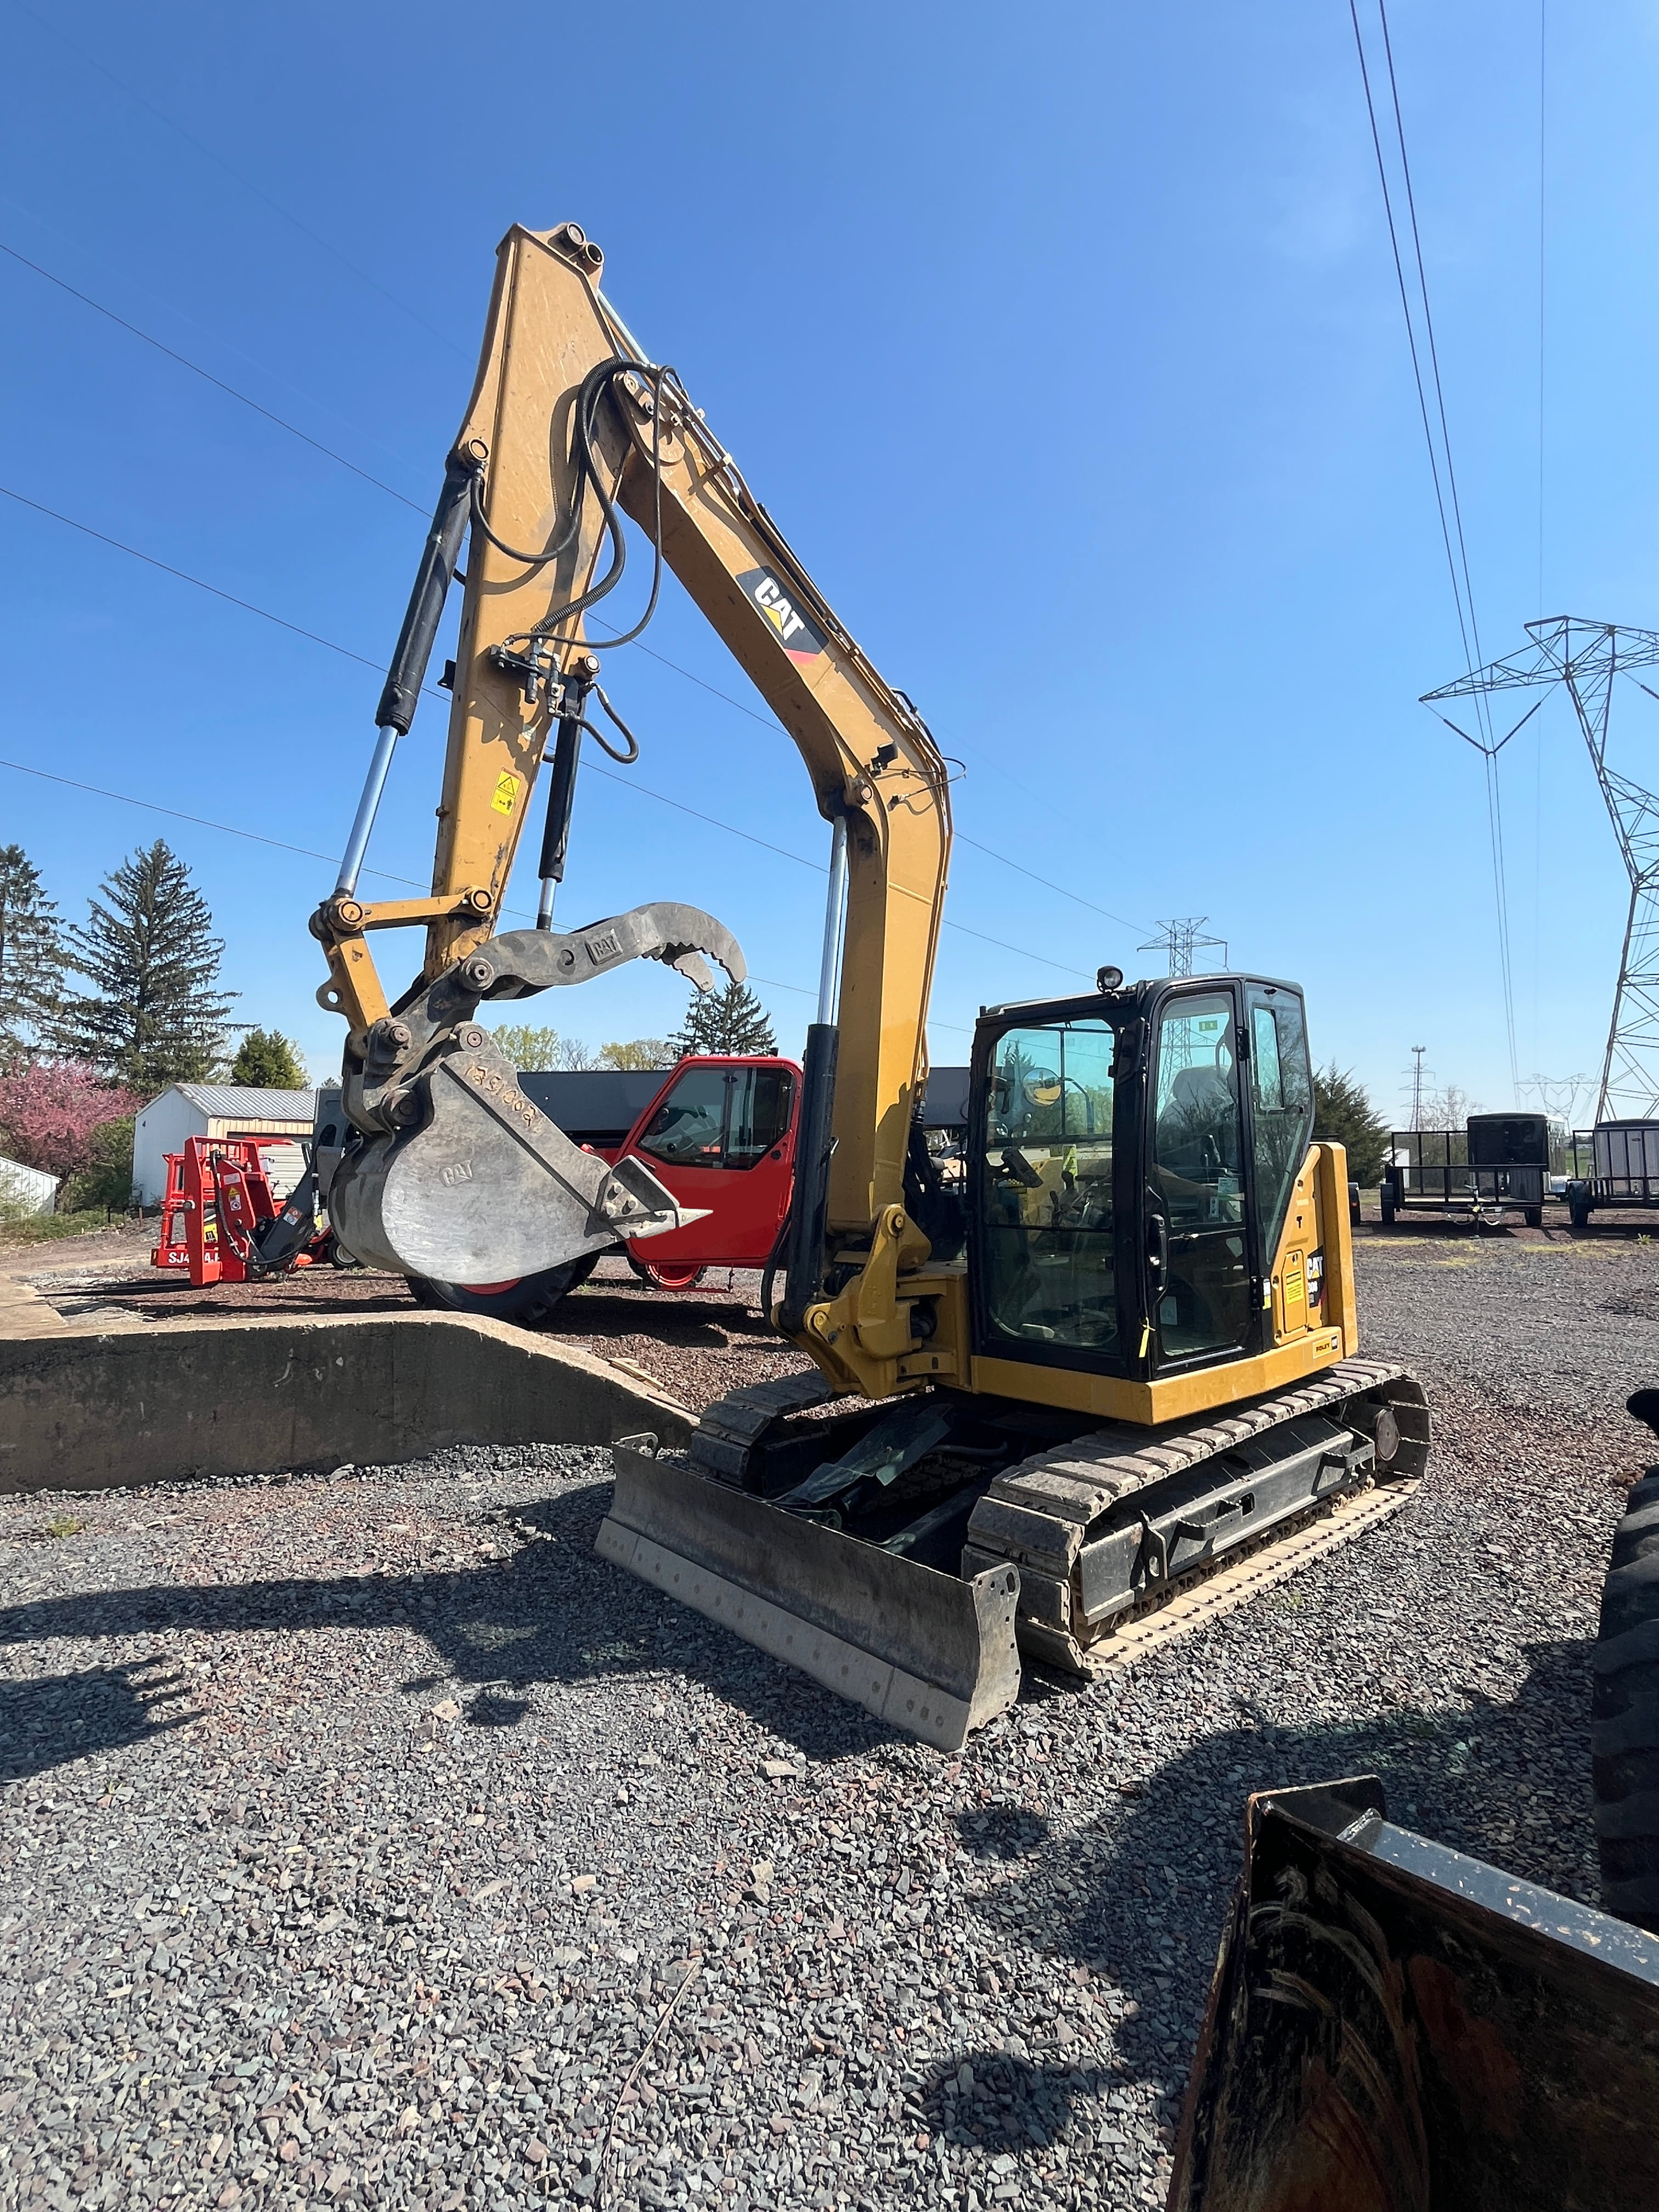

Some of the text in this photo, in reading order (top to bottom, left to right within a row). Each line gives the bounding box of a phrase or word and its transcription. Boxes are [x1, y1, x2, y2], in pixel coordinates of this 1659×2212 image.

[754, 577, 805, 641] CAT
[594, 935, 616, 955] CAT
[440, 1159, 473, 1187] CAT
[168, 1252, 190, 1263] SJ4
[1307, 1256, 1323, 1279] CAT
